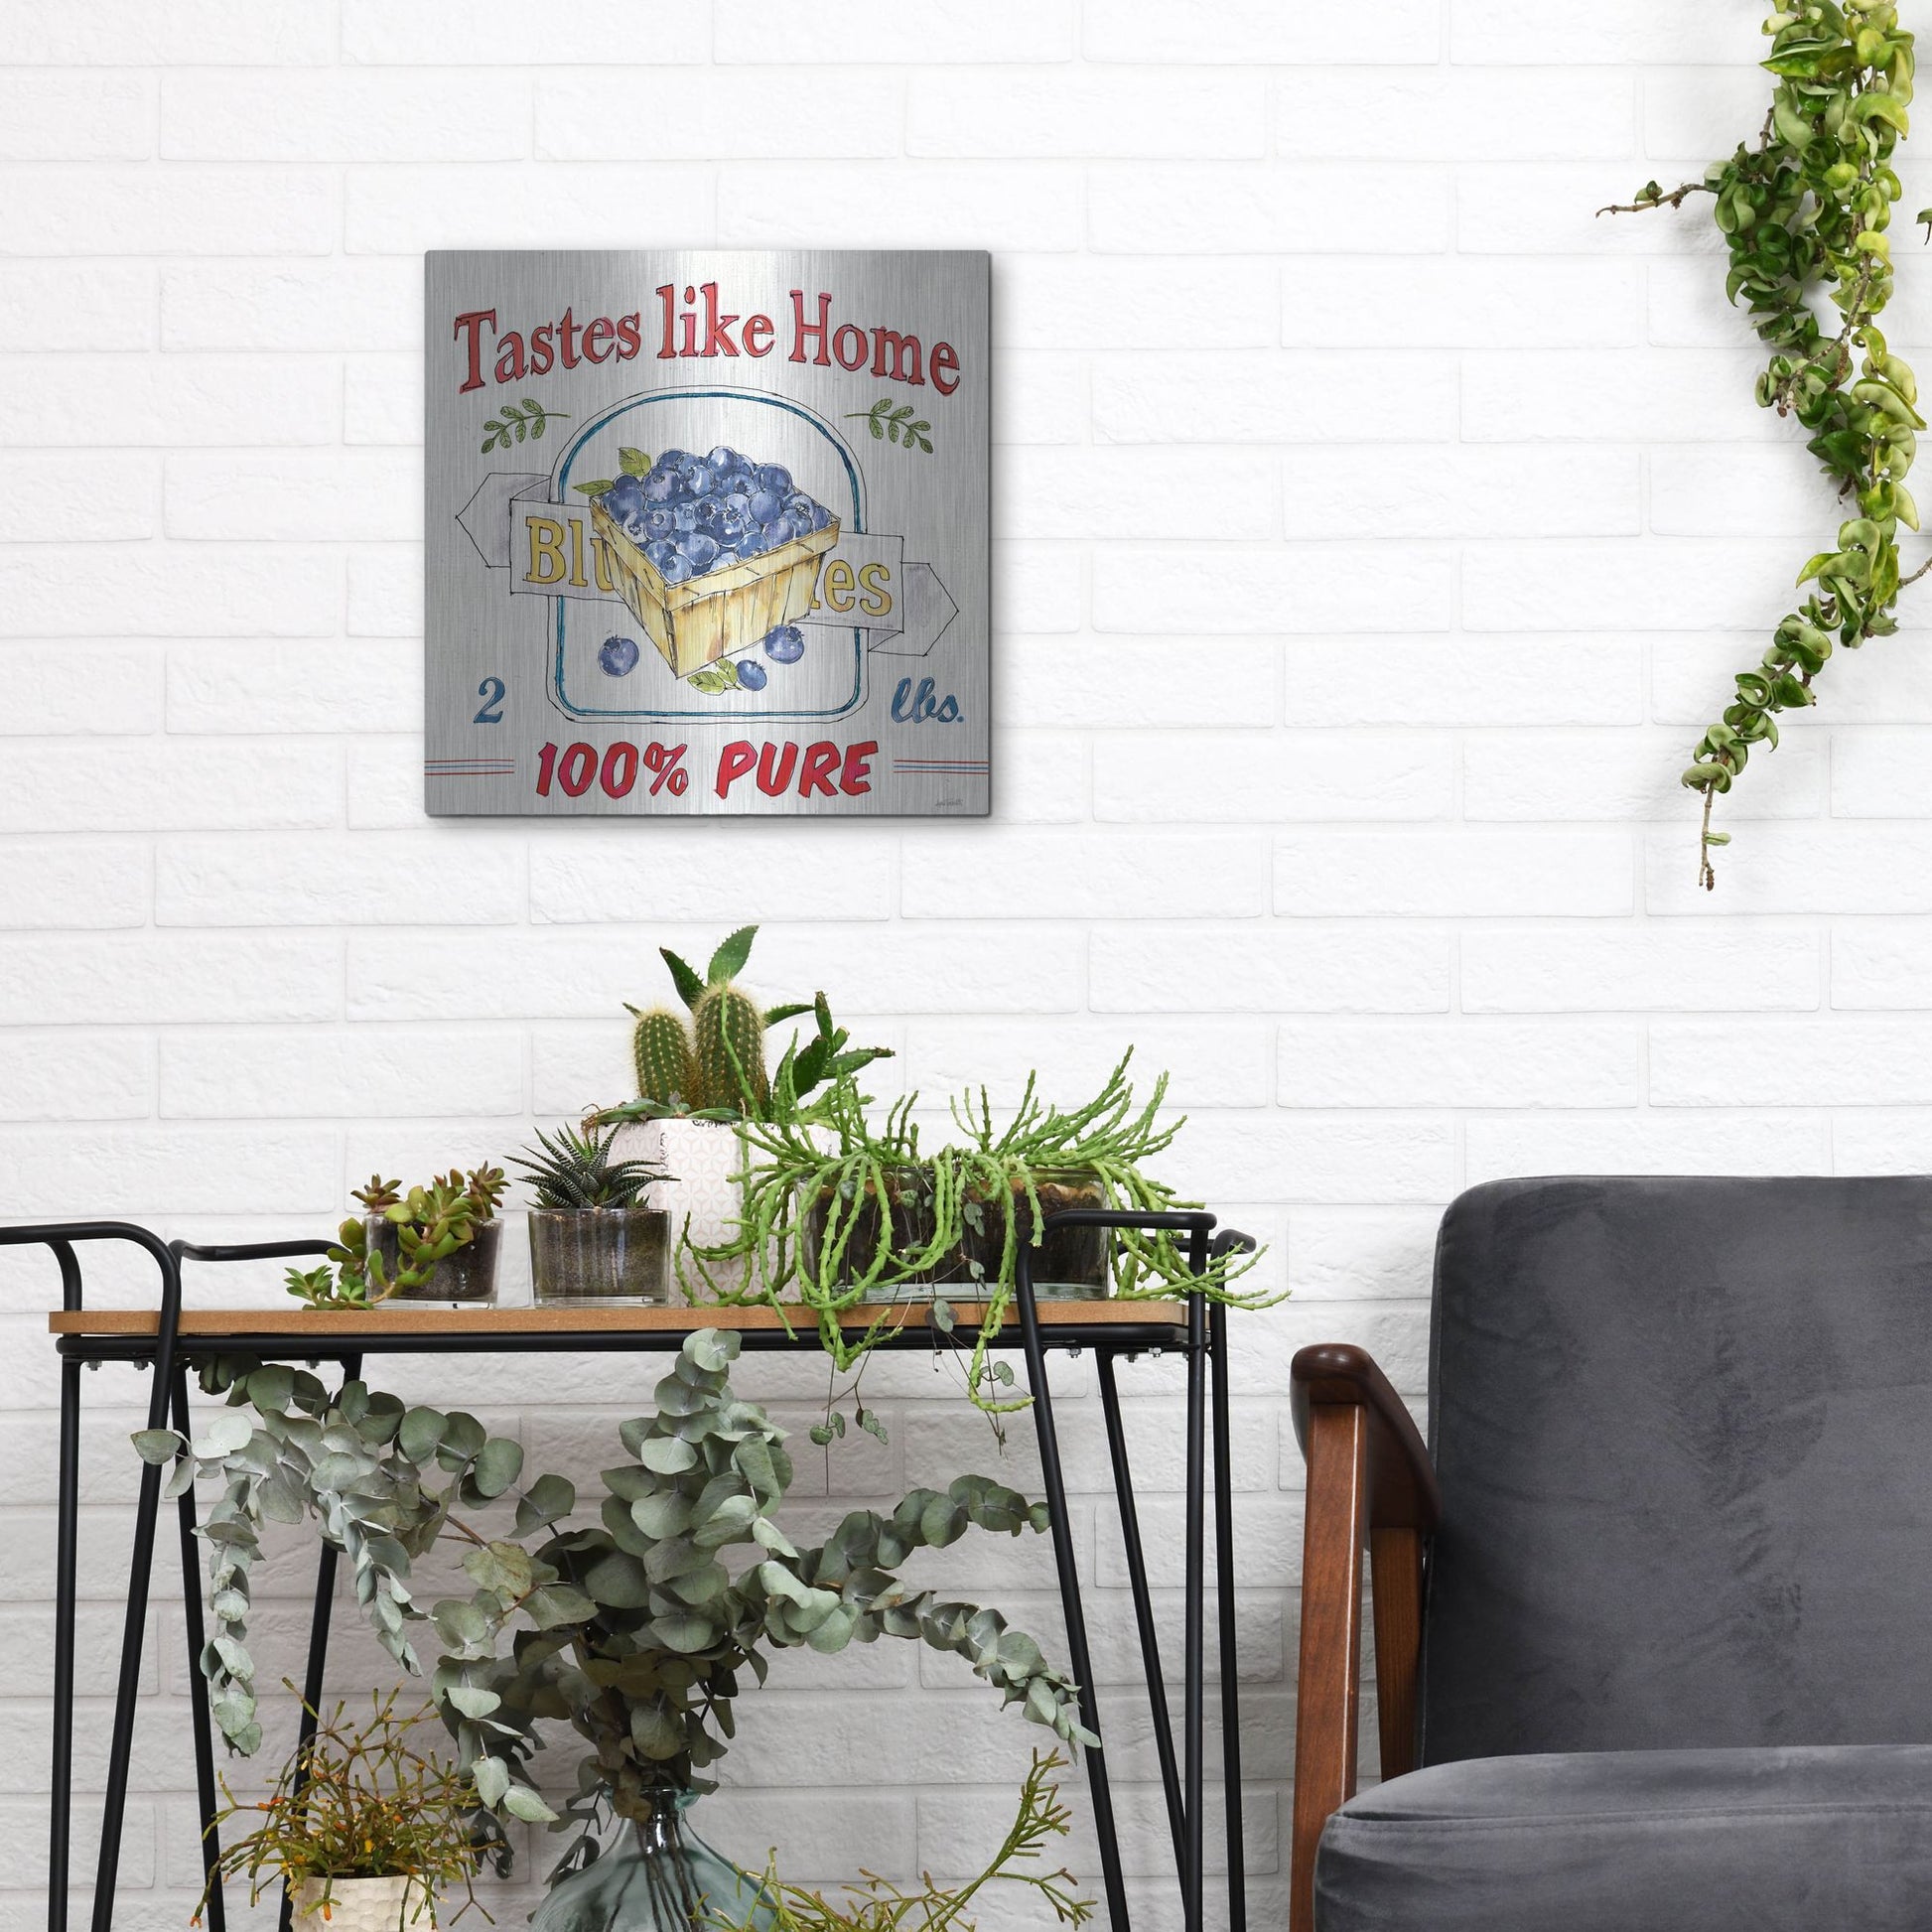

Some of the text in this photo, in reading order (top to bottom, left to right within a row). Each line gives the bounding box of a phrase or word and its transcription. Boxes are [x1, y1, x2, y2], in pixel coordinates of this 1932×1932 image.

[454, 282, 960, 396] Tastes like Home
[474, 678, 963, 723] 2 lbs.
[536, 741, 878, 799] 100% PURE
